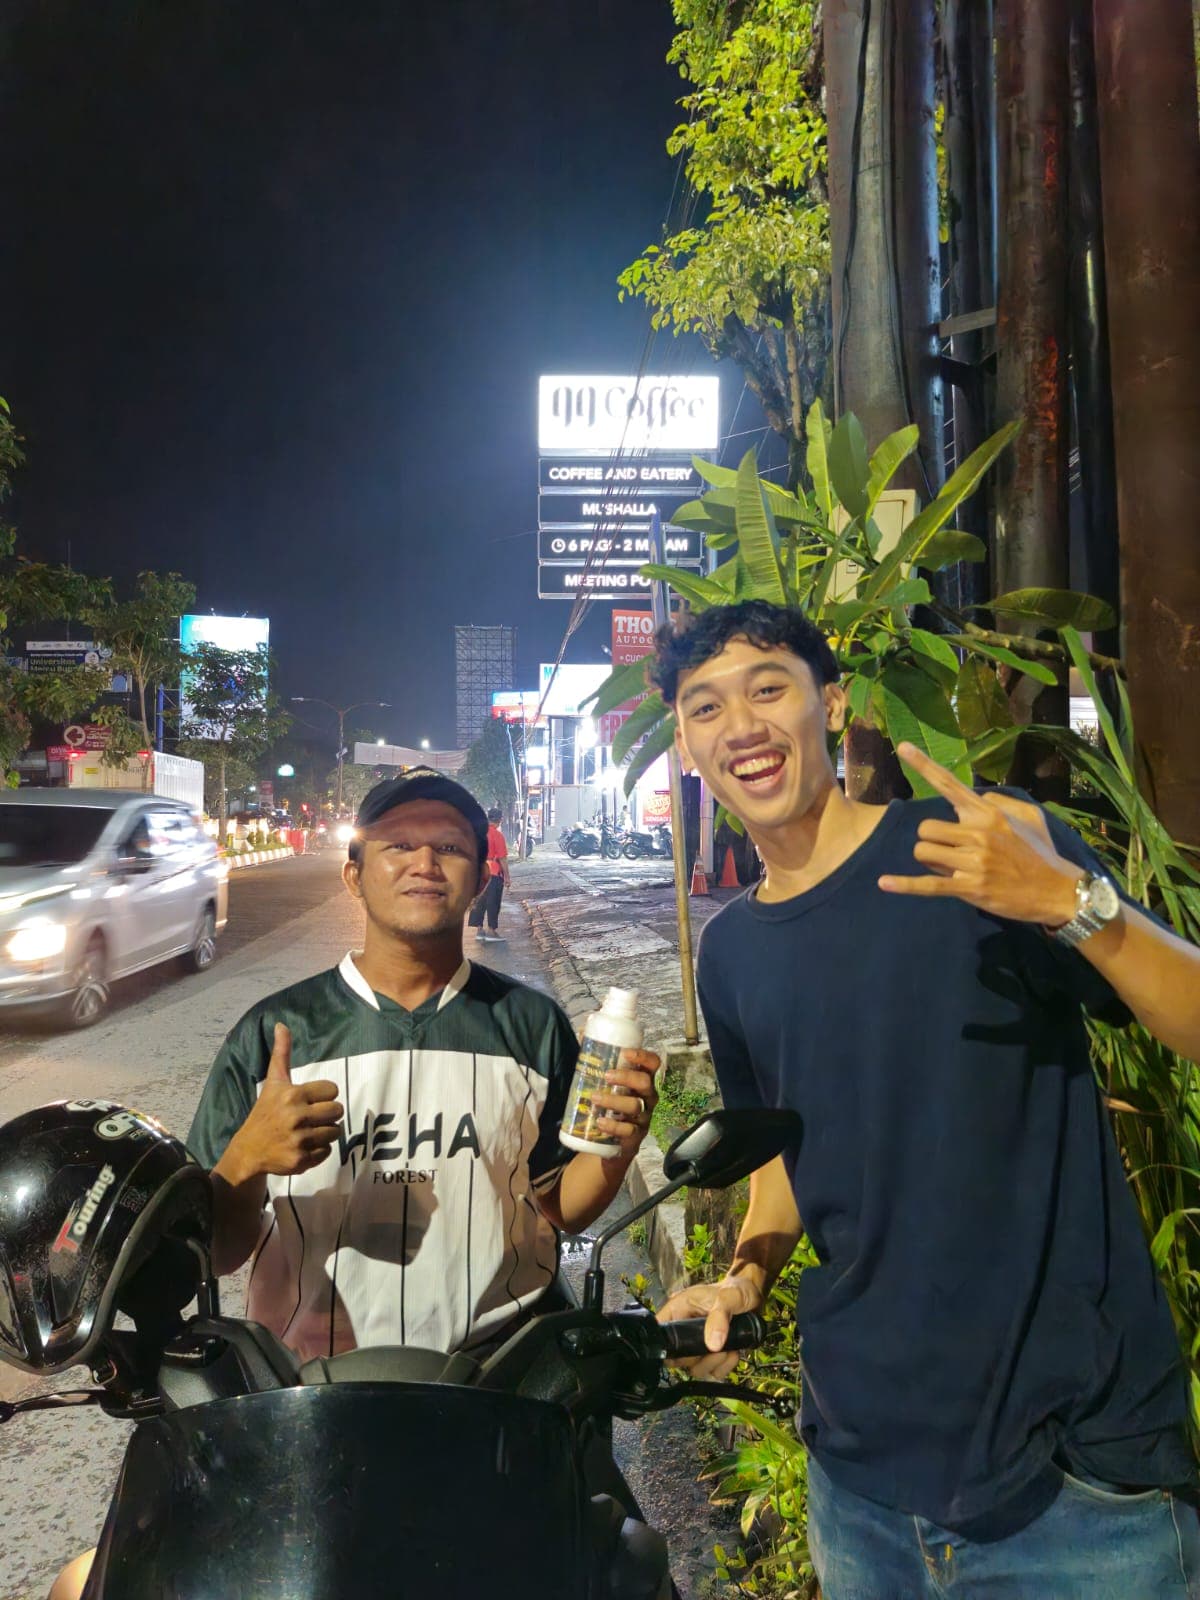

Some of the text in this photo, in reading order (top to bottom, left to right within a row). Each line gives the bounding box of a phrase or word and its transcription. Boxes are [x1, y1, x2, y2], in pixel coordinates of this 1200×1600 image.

[604, 386, 705, 429] Coffee
[549, 467, 693, 481] COFFEE AND EATERY
[568, 539, 577, 551] 6
[623, 539, 632, 551] 2
[338, 1111, 481, 1166] HEHA
[373, 1169, 438, 1185] FOREST
[53, 1166, 116, 1253] Touring
